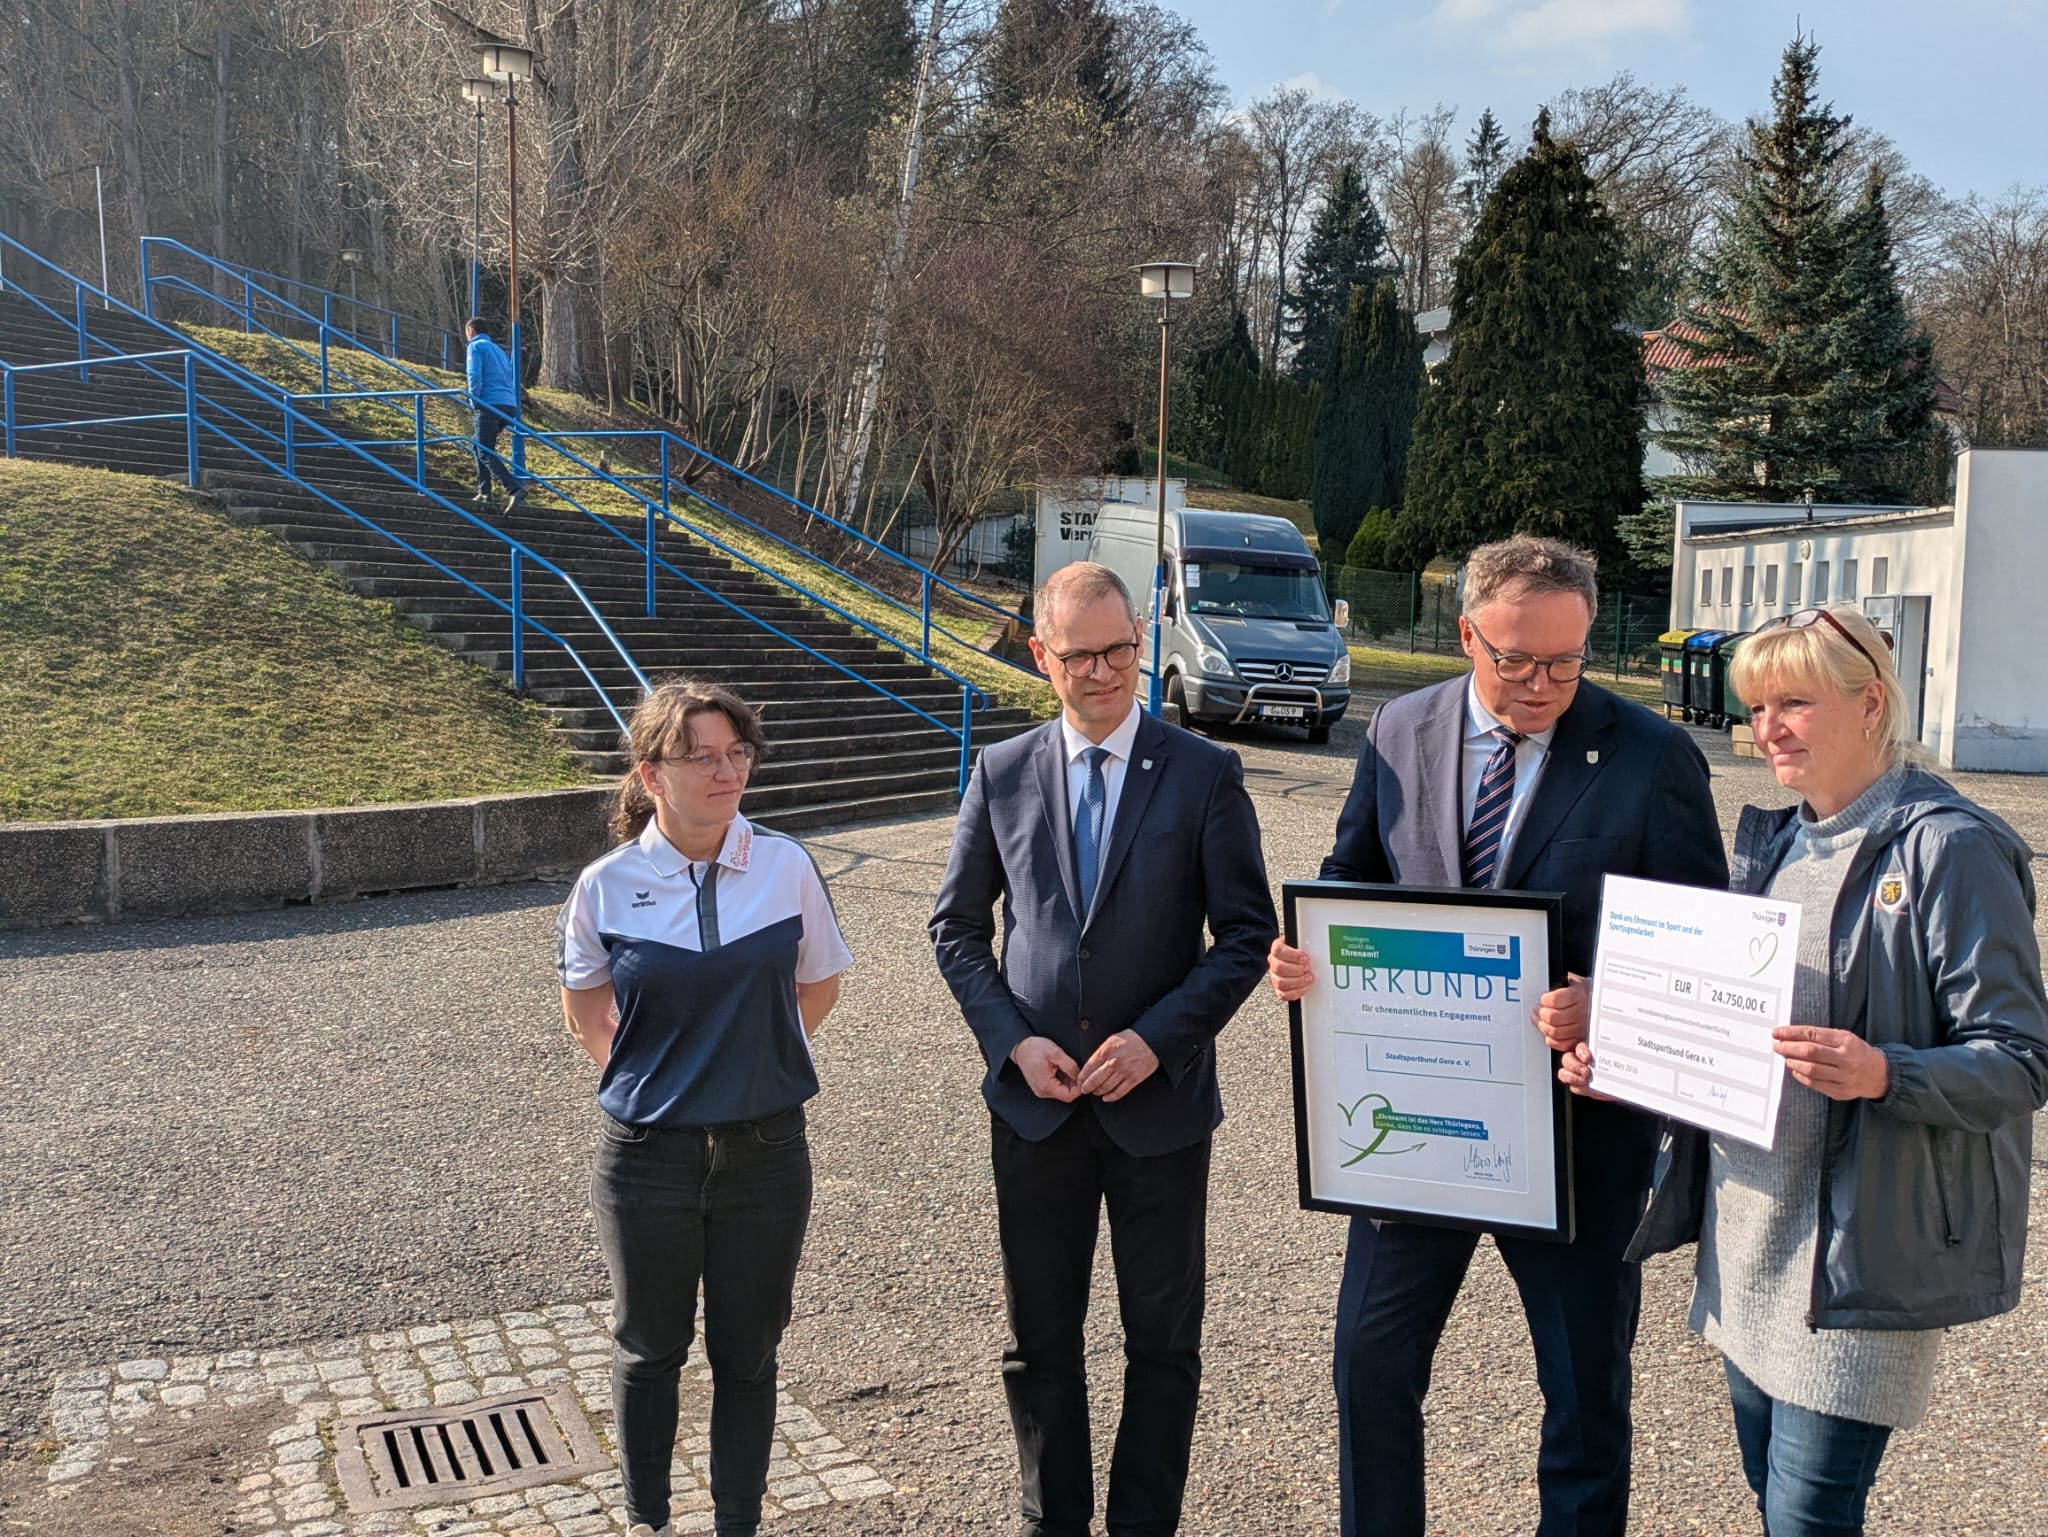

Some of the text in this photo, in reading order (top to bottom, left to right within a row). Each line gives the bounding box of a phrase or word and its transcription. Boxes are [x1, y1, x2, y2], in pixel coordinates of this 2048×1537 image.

[1609, 911, 1623, 920] Dank
[1634, 915, 1658, 927] Ehrenamt
[1666, 922, 1681, 932] Sport
[1682, 925, 1692, 934] und
[1694, 926, 1704, 936] der
[1341, 948, 1379, 959] Ehrenamt!
[1333, 964, 1521, 1003] URKUNDE
[1674, 979, 1692, 994] EUR
[1711, 989, 1767, 1013] 24.750,00 €
[1361, 1004, 1491, 1022] für ehrenamtliches Engagement
[1385, 1052, 1438, 1065] Stadtsportbund
[1439, 1057, 1455, 1066] Gera
[1637, 1036, 1684, 1058] Stadtsportbund
[1685, 1050, 1700, 1063] Gera
